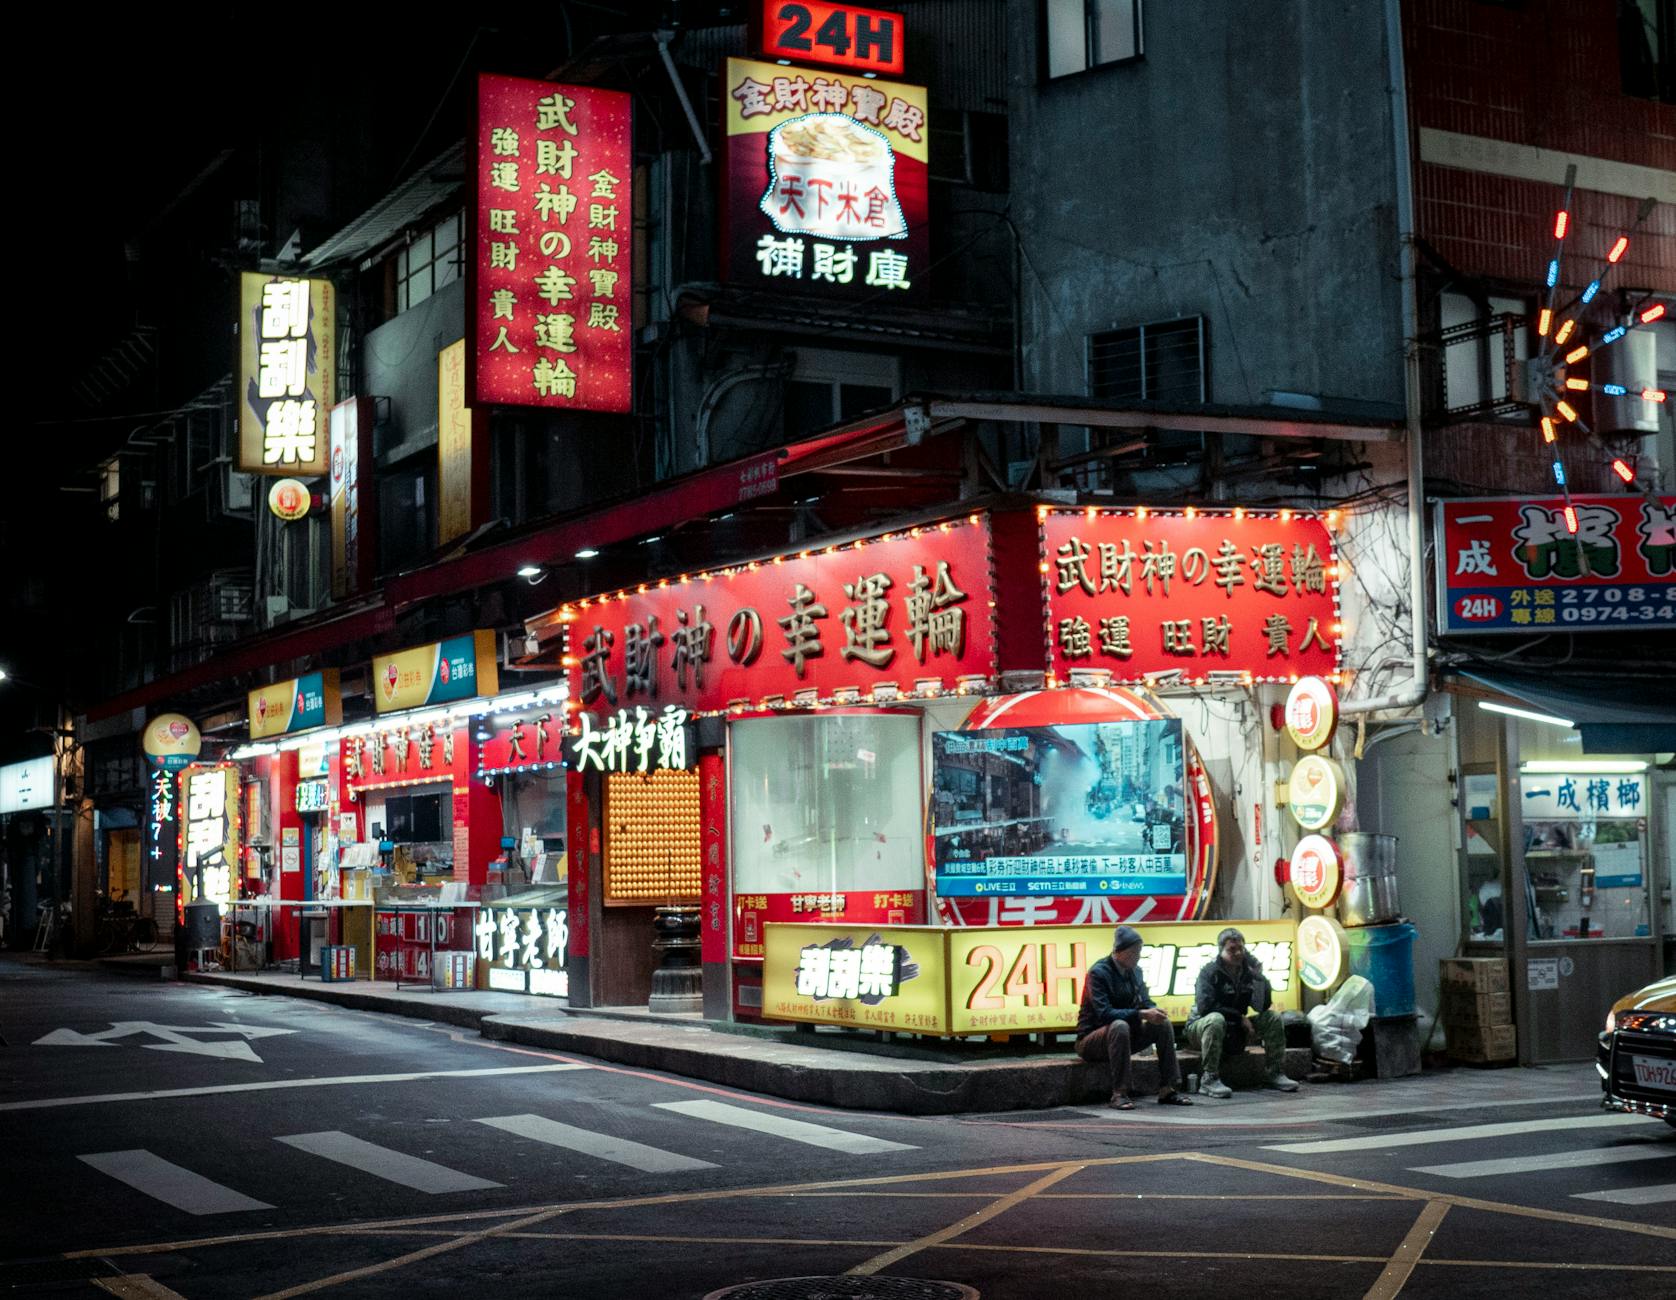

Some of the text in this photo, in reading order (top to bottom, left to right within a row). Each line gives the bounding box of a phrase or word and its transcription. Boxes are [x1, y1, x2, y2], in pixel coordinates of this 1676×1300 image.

[777, 1, 893, 63] 24H
[732, 76, 924, 142] 金財神寶殿
[779, 176, 889, 228] 天下米倉
[489, 127, 520, 354] 強運 旺財 貴人
[532, 93, 578, 398] 武財神の幸運輪
[587, 169, 620, 331] 金財神寶殿
[756, 234, 911, 289] 補財庫
[1056, 536, 1327, 597] 武財神の幸運輪
[1455, 515, 1498, 576] 一成
[580, 560, 967, 705] 武財神の幸運輪
[1058, 613, 1331, 658] 強運 旺財 貴人
[1461, 598, 1497, 617] 24H
[1525, 777, 1641, 812] 一成檳榔
[966, 942, 1087, 1010] 24H
